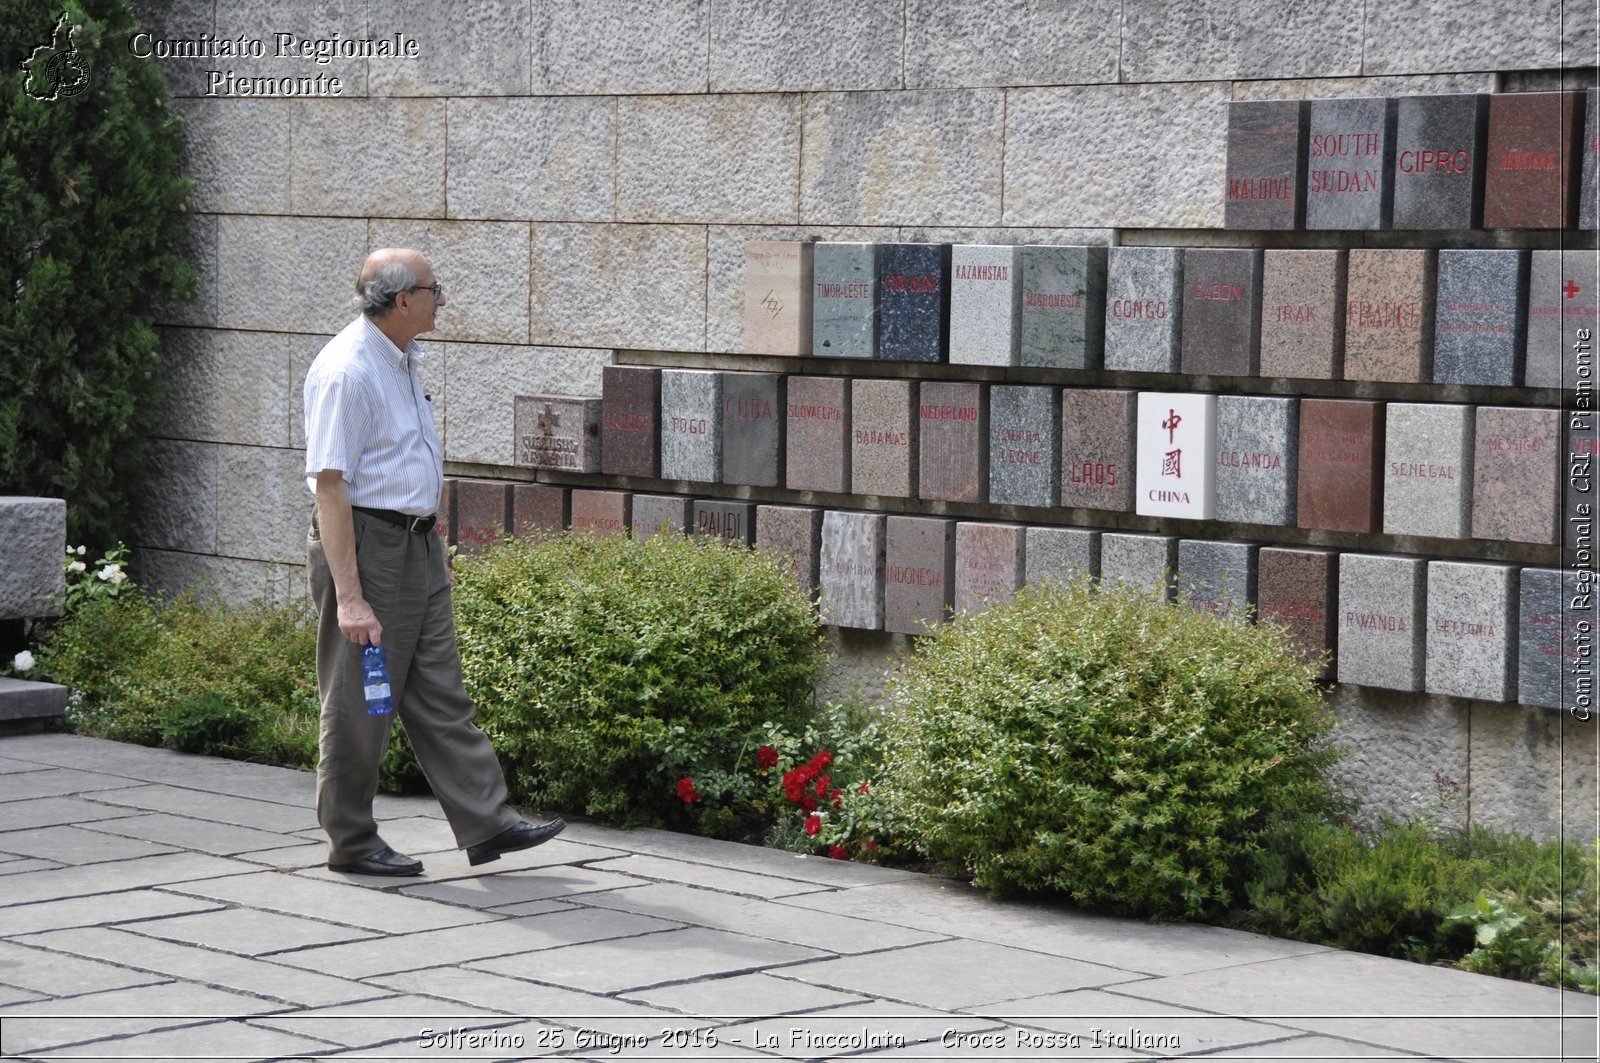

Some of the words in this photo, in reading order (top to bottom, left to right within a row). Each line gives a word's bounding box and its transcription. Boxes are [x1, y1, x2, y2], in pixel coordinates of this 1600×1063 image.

[1312, 133, 1380, 158] SOUTH
[1399, 149, 1470, 174] CIPRO
[1229, 178, 1292, 201] MALDIVE
[1311, 169, 1378, 193] SUDAN
[955, 264, 1008, 281] KAZAKHSTAN
[816, 283, 869, 300] TIMOR-LESTE
[1026, 292, 1083, 309] MICRONESIA
[1191, 283, 1243, 302] GABON
[1113, 300, 1167, 320] CONGO
[1277, 305, 1317, 322] IRAK
[1349, 300, 1420, 332] FRANCE
[725, 396, 773, 421] CUBA
[788, 404, 842, 421] SLOVACCHIA
[920, 404, 978, 423] NEDERLAND
[671, 416, 707, 435] TOGO
[856, 431, 907, 446] BAHAMAS
[999, 429, 1041, 444] SIERRA
[1161, 408, 1183, 479] 中國
[1488, 438, 1541, 453] MESSICO
[1000, 448, 1041, 465] LEONE
[1220, 450, 1282, 471] UGANDA
[1072, 461, 1117, 487] LAOS
[1391, 462, 1455, 480] SENEGAL
[1148, 488, 1191, 504] CHINA
[822, 562, 873, 577] COLOMBIA
[885, 564, 942, 588] INDONESIA
[1345, 611, 1408, 633] RWANDA
[1435, 619, 1496, 638] LETTONIA
